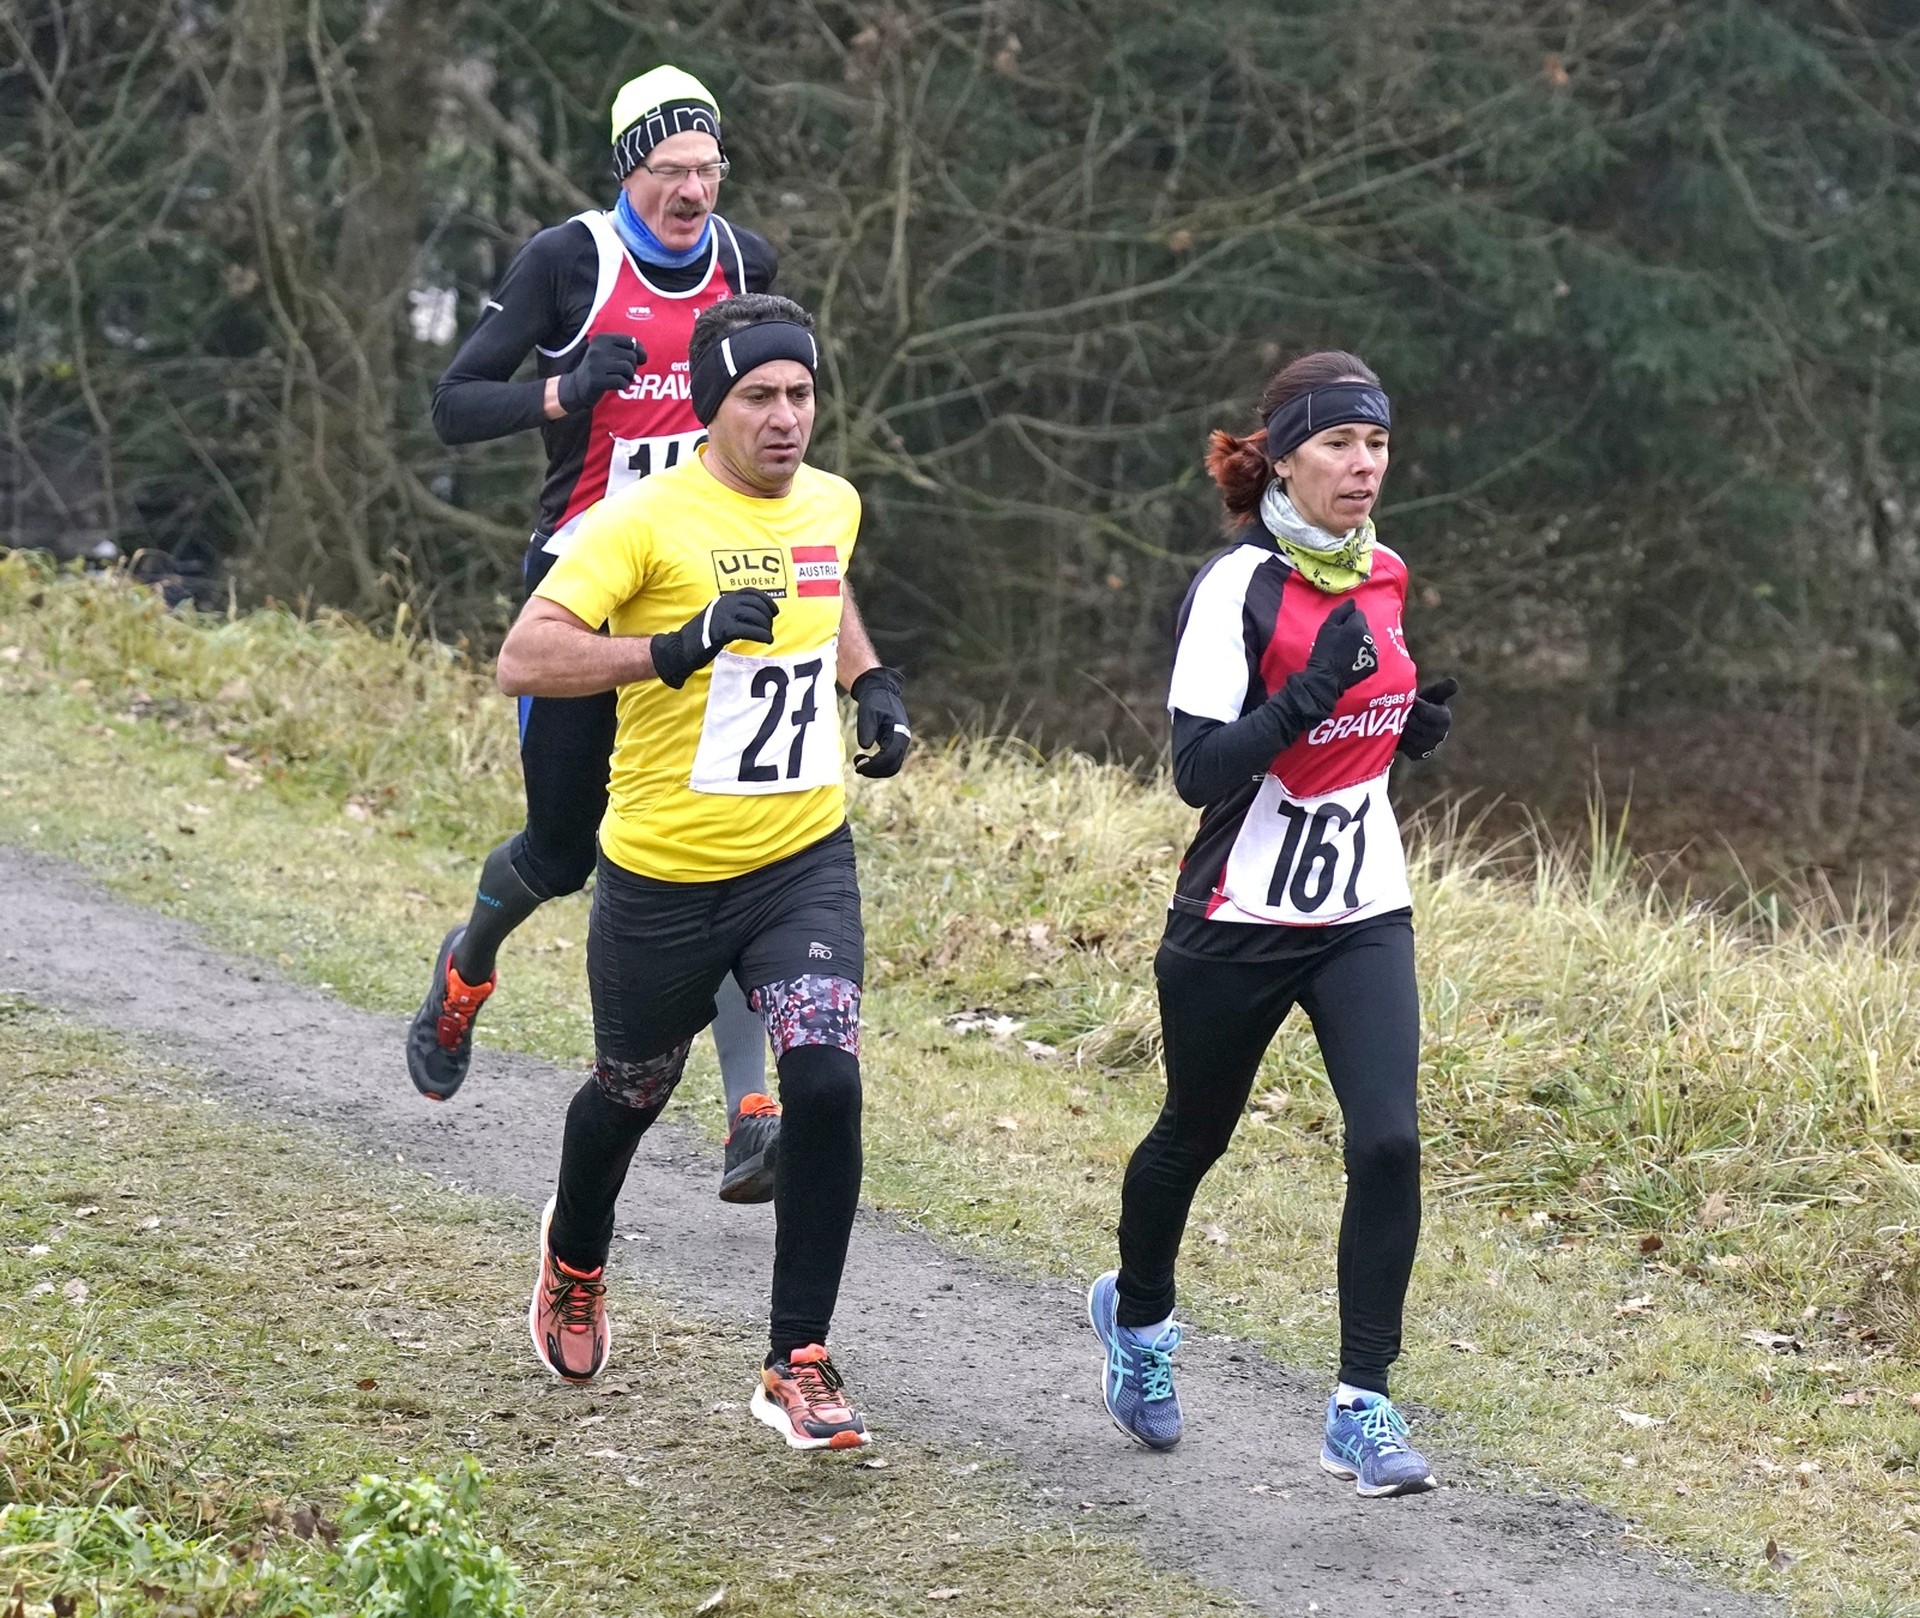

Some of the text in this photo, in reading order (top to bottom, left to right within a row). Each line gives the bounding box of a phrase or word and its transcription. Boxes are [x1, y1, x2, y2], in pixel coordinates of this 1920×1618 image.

[671, 361, 690, 371] erd
[617, 374, 693, 400] GRAV
[719, 554, 780, 574] ULC
[799, 565, 838, 577] AUSTRIA
[730, 577, 776, 586] BLUDENZ
[1369, 693, 1405, 708] erdgas
[738, 658, 823, 782] 27
[1266, 792, 1371, 913] 161
[808, 948, 833, 960] PRO
